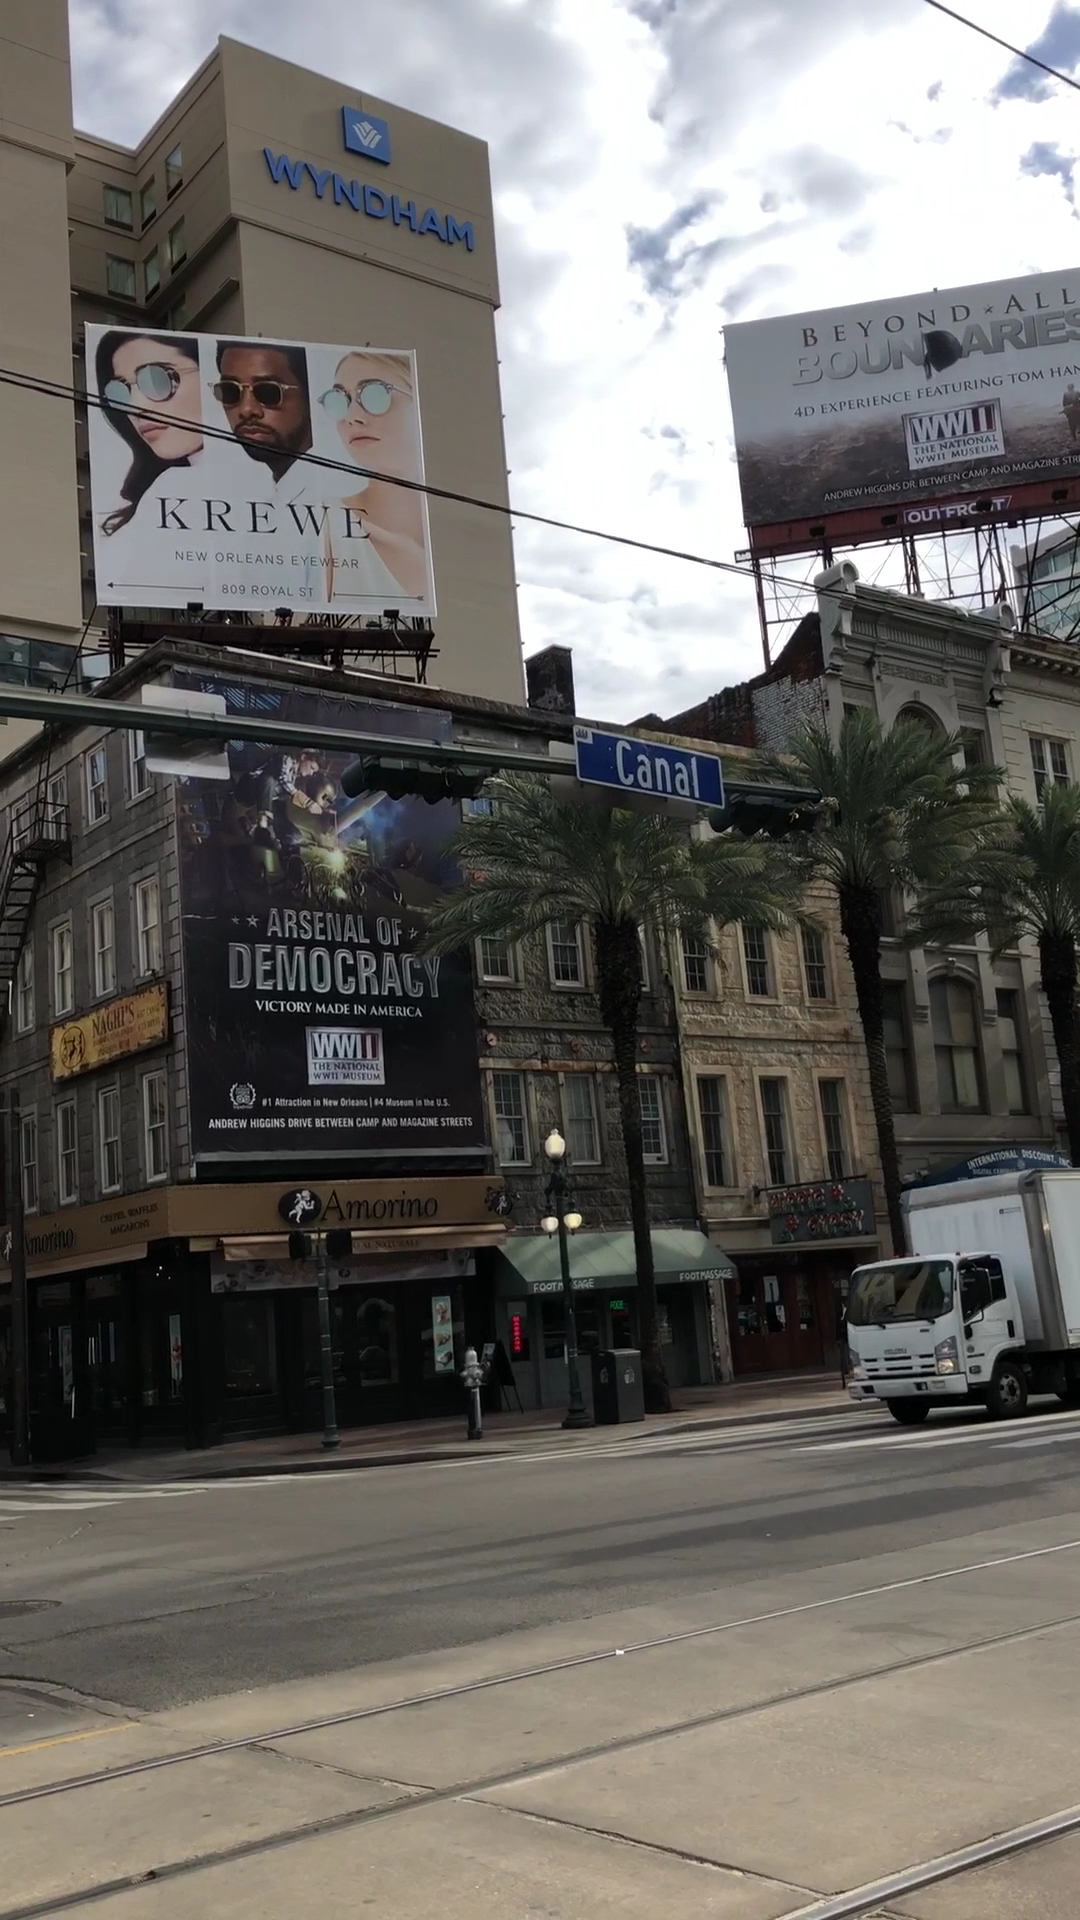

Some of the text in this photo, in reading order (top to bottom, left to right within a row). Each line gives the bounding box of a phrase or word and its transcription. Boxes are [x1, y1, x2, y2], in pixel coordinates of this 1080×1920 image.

[263, 147, 474, 251] WYNDHAM
[801, 288, 1076, 347] BEYOND ALL
[794, 406, 815, 418] 4D
[821, 390, 911, 414] EXPERIENCE
[917, 375, 1003, 399] FEATURING
[1007, 370, 1044, 384] TOM
[911, 406, 988, 443] WWII
[913, 433, 998, 456] THE NATIONAL
[914, 444, 999, 465] WWII MUSEUM
[824, 487, 862, 502] ANDREW
[864, 482, 901, 495] HIGGINS
[919, 472, 960, 488] BETWEEN
[962, 468, 988, 480] CAMP
[991, 465, 1010, 475] AND
[1012, 456, 1060, 472] MAGAZINE
[156, 497, 370, 539] KREWE
[907, 498, 1005, 523] OUTFROT
[175, 551, 359, 569] NEW ORLEANS EYEWEAR
[221, 584, 314, 597] 809 ROYAL ST
[616, 740, 700, 798] Canal
[267, 908, 403, 946] ARSENAL OF
[228, 942, 441, 998] DEMOCRACY
[255, 1000, 423, 1018] VICTORY MADE IN AMERICA
[313, 1032, 374, 1059] WWII
[313, 1062, 380, 1072] THE NATIONAL
[313, 1071, 381, 1081] WWII MUSEUM
[262, 1098, 272, 1107] #1
[275, 1097, 311, 1107] Attraction
[314, 1098, 320, 1107] in
[323, 1098, 339, 1107] New
[340, 1097, 368, 1107] Orleans
[386, 1097, 414, 1107] Museum
[416, 1098, 422, 1107] in
[424, 1098, 434, 1107] the
[209, 1116, 473, 1128] ANDREW HIGGINS DRIVE BETWEEN CAMP AND MAGAZINE STREETS
[967, 1149, 1018, 1170] INTERNATIONAL
[322, 1189, 438, 1221] Amorino
